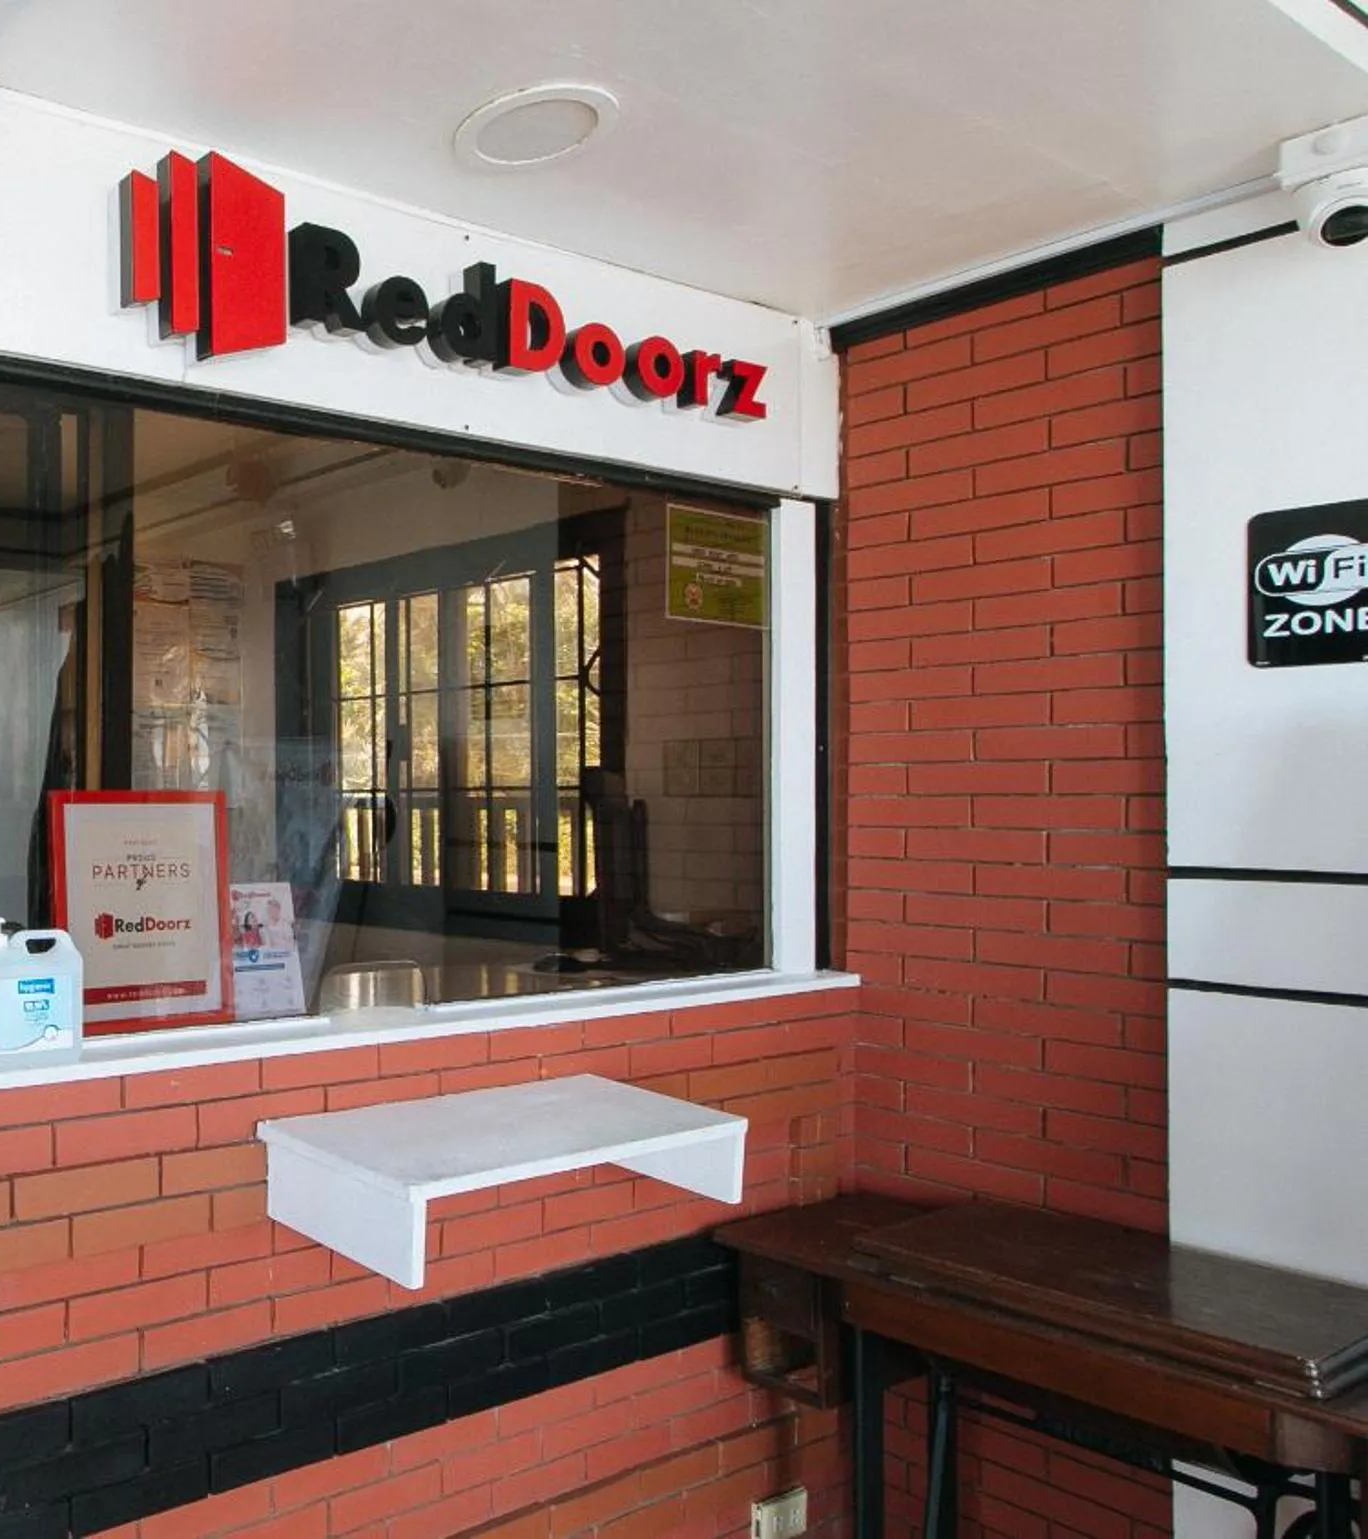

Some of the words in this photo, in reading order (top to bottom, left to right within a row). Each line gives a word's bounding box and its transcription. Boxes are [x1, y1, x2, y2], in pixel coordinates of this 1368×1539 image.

[288, 221, 768, 422] RedDoorz
[92, 862, 191, 879] PARTNERS
[115, 916, 192, 933] RedDoorz
